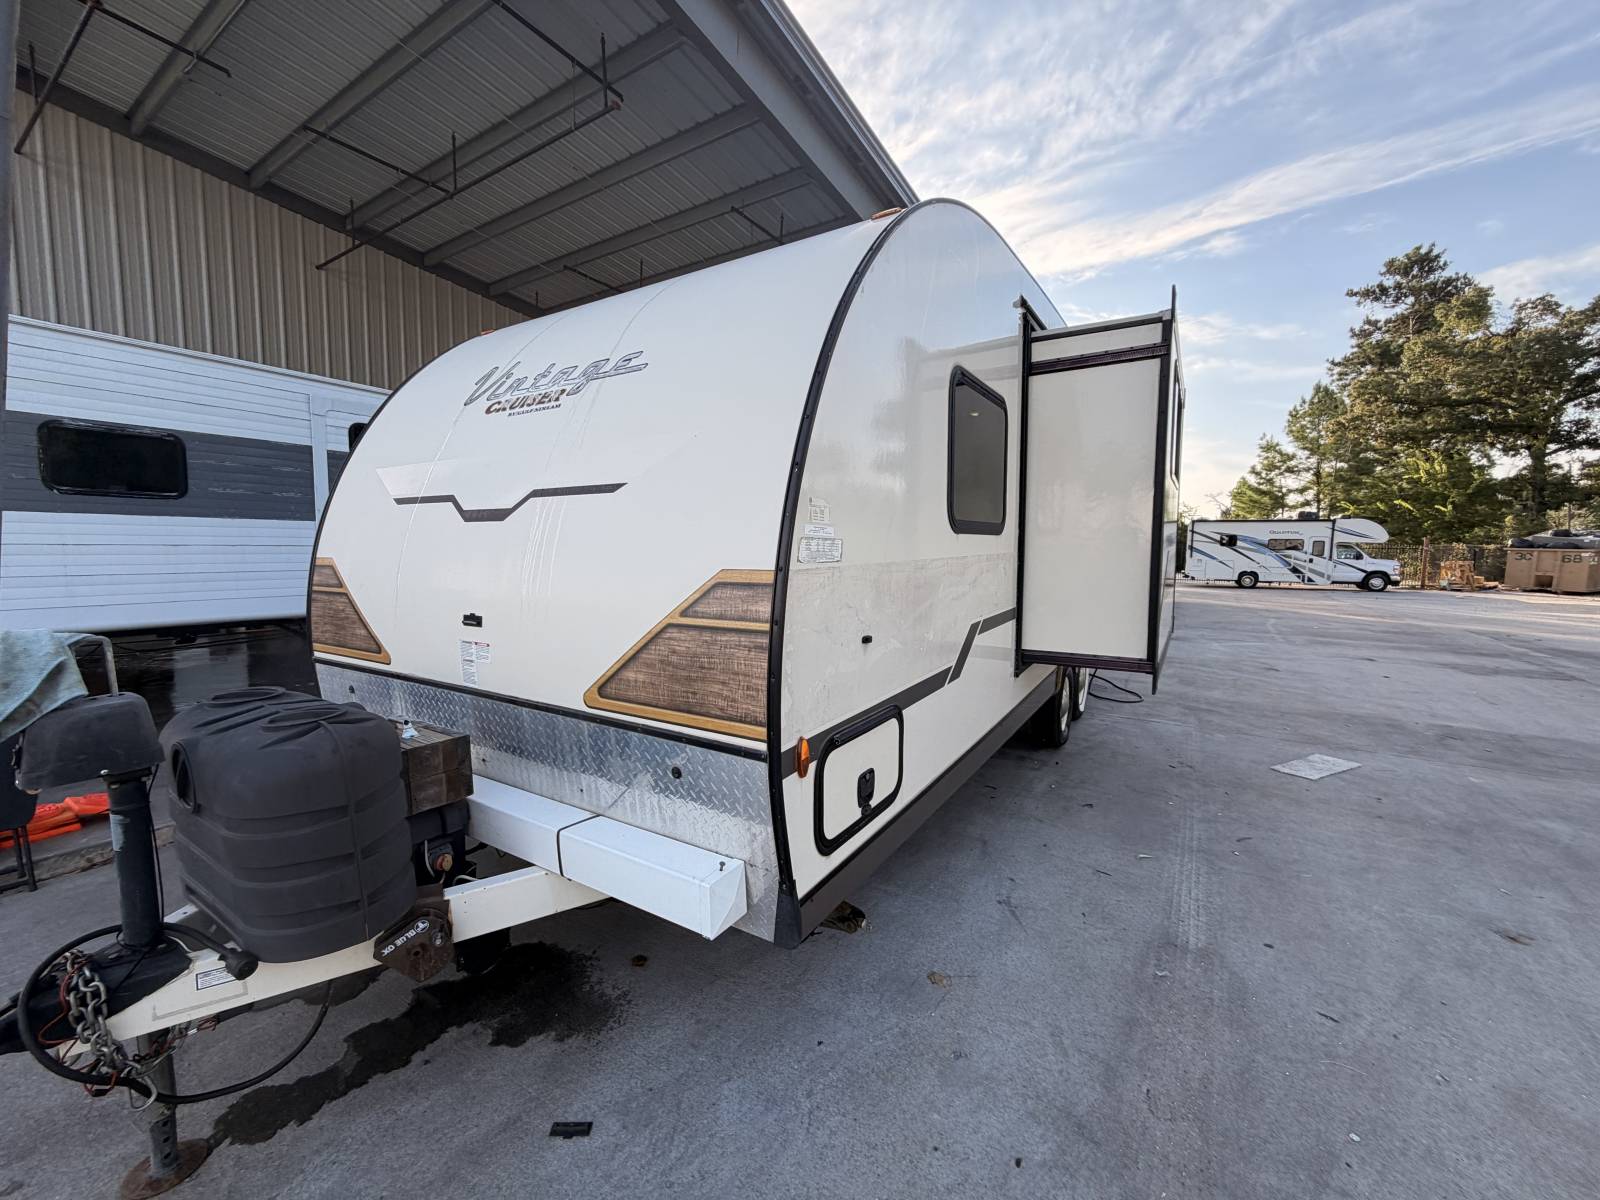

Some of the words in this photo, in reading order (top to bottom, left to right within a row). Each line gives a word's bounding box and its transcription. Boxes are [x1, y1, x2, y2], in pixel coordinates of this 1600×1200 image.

[464, 350, 648, 406] Vintage
[485, 389, 567, 415] CRUISER
[393, 929, 417, 946] BLUE
[381, 944, 396, 957] OX
